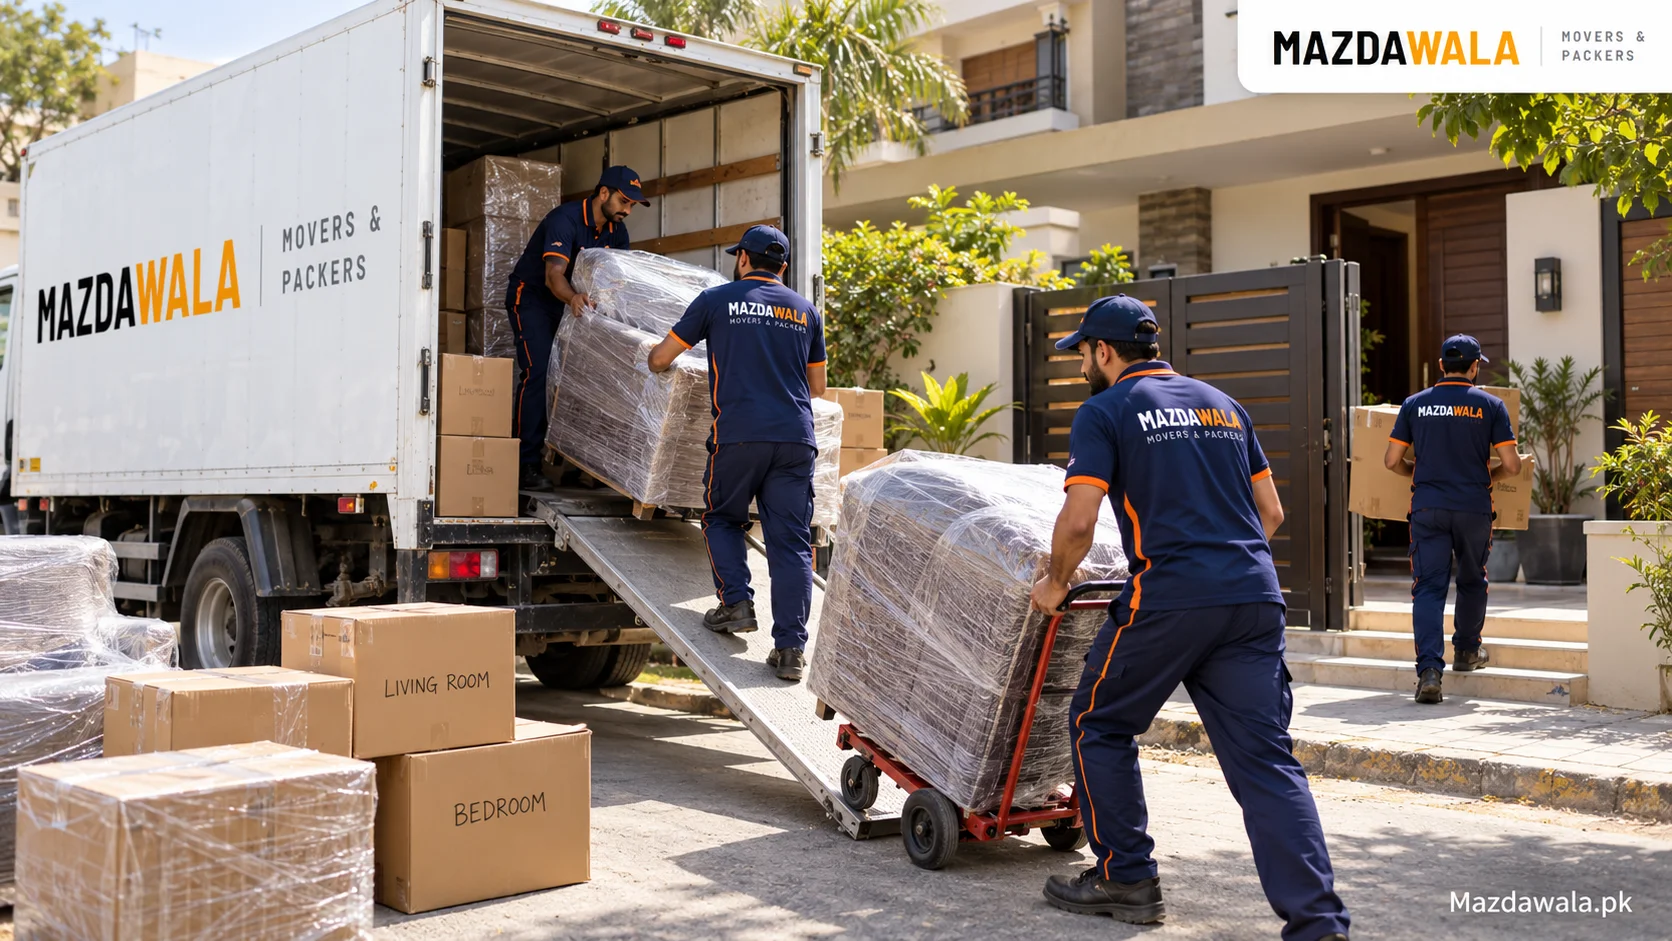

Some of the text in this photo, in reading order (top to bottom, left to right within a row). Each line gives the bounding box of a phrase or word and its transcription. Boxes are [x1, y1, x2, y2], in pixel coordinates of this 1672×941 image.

[282, 205, 381, 253] MOVERS &
[282, 254, 366, 295] PACKERS
[37, 239, 241, 344] MAZDAWALA
[728, 301, 808, 327] MAZDAWALA
[729, 317, 761, 325] MOVERS
[1137, 408, 1243, 431] MAZDAWALA
[1418, 405, 1483, 419] MAZDAWALA
[1146, 430, 1189, 444] MOVERS
[1193, 430, 1200, 439] &
[384, 671, 490, 698] LIVING ROOM
[453, 791, 546, 827] BEDROOM
